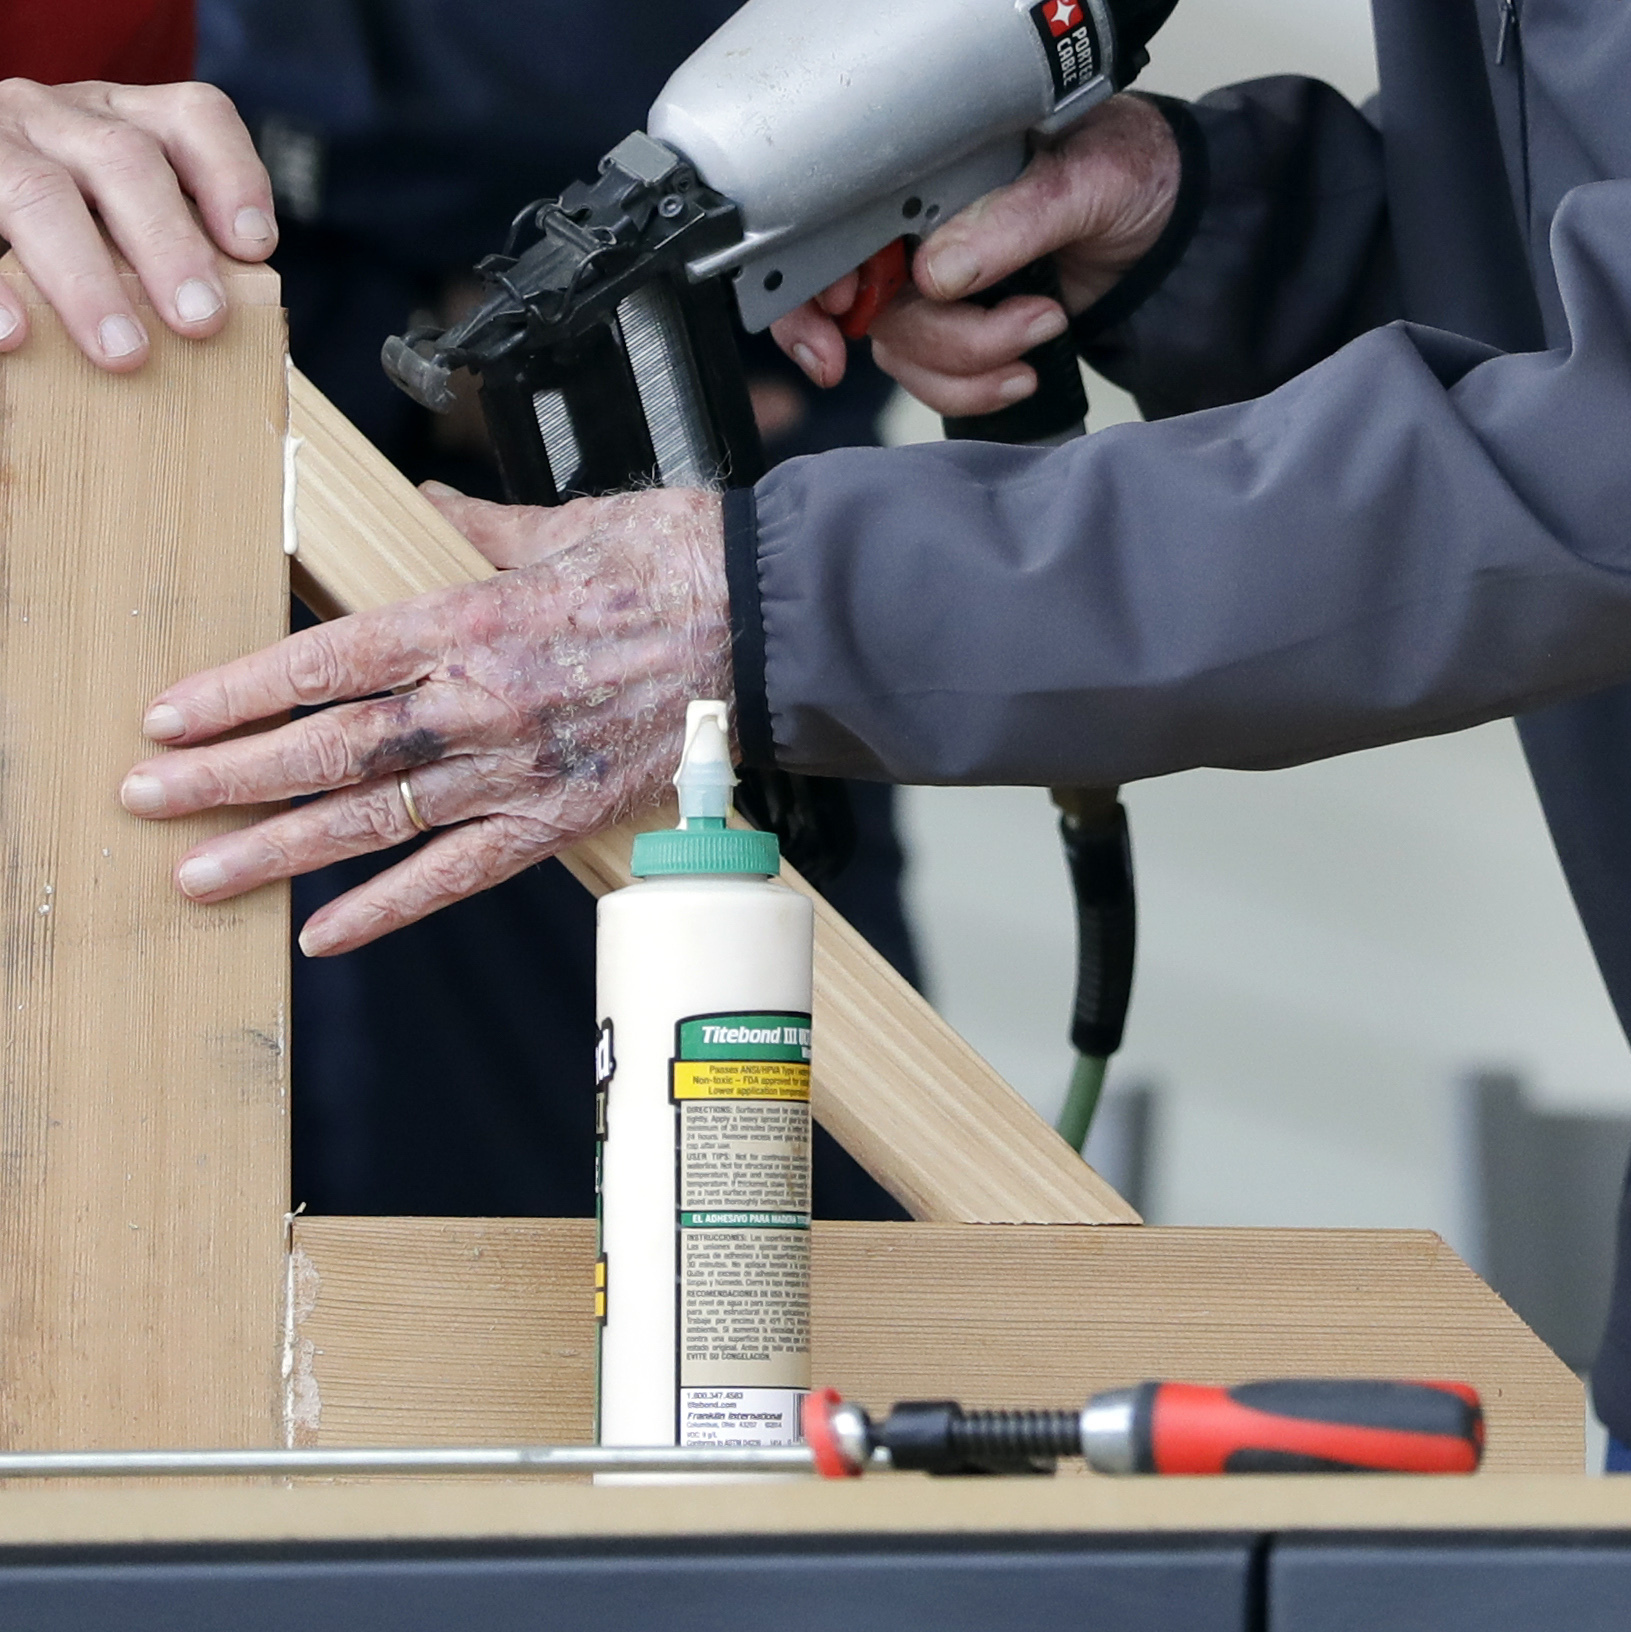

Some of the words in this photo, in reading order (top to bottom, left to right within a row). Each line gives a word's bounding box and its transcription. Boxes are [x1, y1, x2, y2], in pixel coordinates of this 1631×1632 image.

[1057, 37, 1077, 87] CABLE
[1072, 26, 1094, 85] PORTER
[702, 1026, 780, 1044] Titebond
[783, 1027, 797, 1044] III
[709, 1066, 738, 1074] Passes
[693, 1076, 733, 1084] Non-toxic
[743, 1076, 759, 1084] FDA
[692, 1214, 703, 1223] EL
[705, 1215, 747, 1223] ADHESIVO
[750, 1215, 769, 1224] PARA
